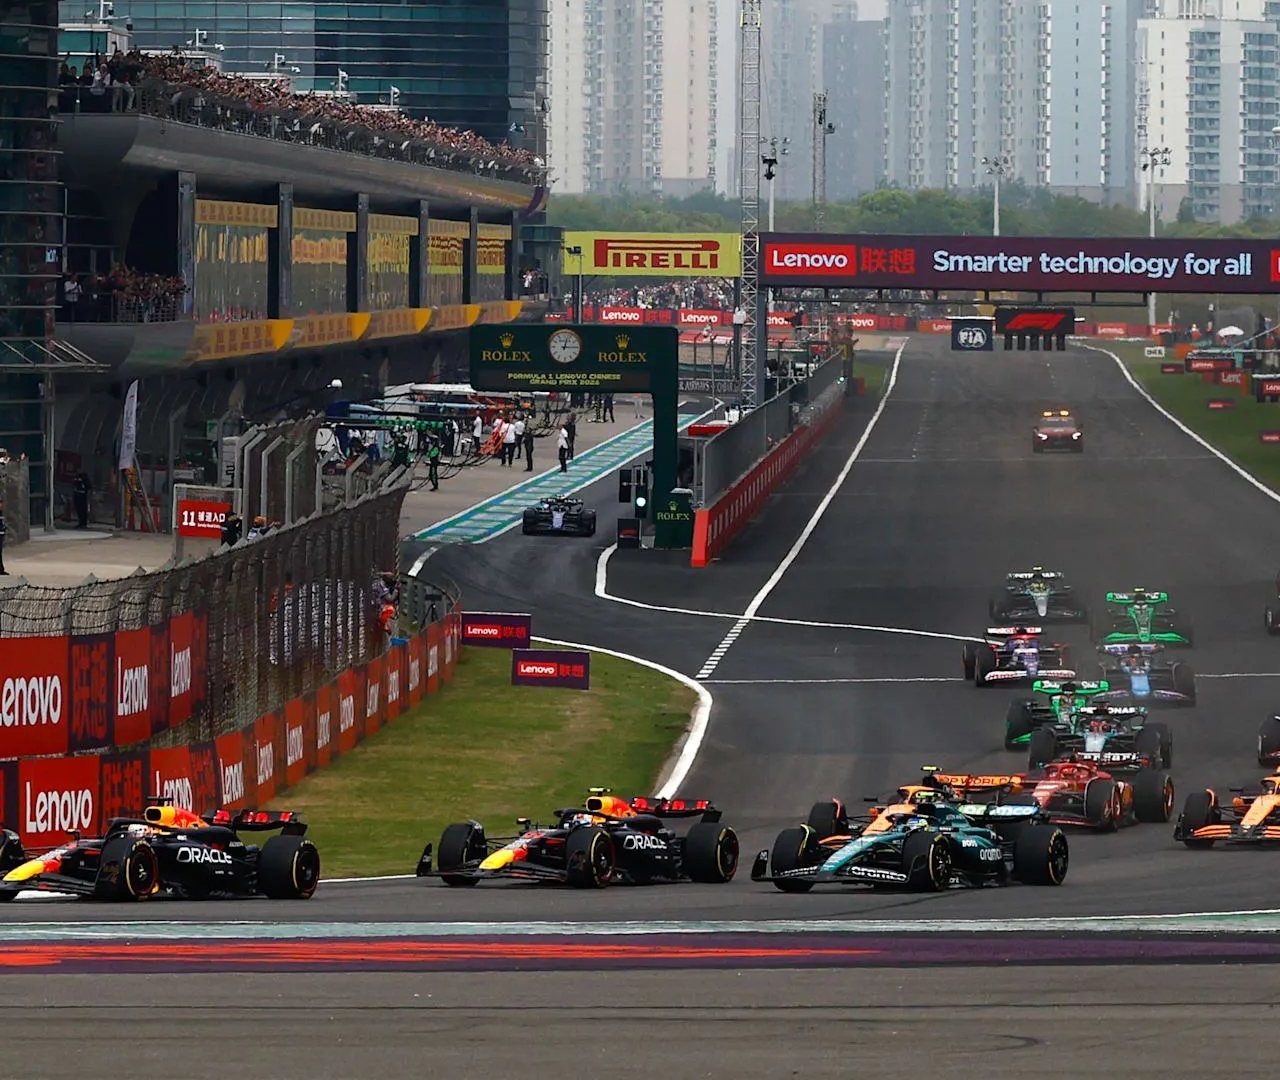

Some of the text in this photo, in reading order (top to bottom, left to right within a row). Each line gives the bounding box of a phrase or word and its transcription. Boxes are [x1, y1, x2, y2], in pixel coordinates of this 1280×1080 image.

[594, 239, 719, 269] PIRELLI
[772, 250, 849, 268] Lenovo
[860, 247, 916, 274] 联想
[933, 249, 1032, 273] Smarter
[1039, 250, 1180, 279] technology
[1183, 253, 1220, 276] for
[1223, 252, 1252, 276] all
[602, 309, 640, 321] Lenovo
[681, 312, 718, 324] Lenovo
[959, 328, 983, 346] FIA
[482, 350, 531, 362] ROLEX
[598, 351, 647, 363] ROLEX
[182, 510, 196, 526] 11
[657, 512, 690, 521] ROLEX
[468, 626, 498, 635] Lenovo
[171, 641, 191, 697] Lenovo
[521, 663, 555, 675] Lenovo
[117, 656, 148, 717] Lenovo
[960, 776, 1008, 787] WORLD
[25, 781, 93, 834] Lenovo
[176, 847, 233, 864] ORACLE
[851, 865, 907, 882] aramco
